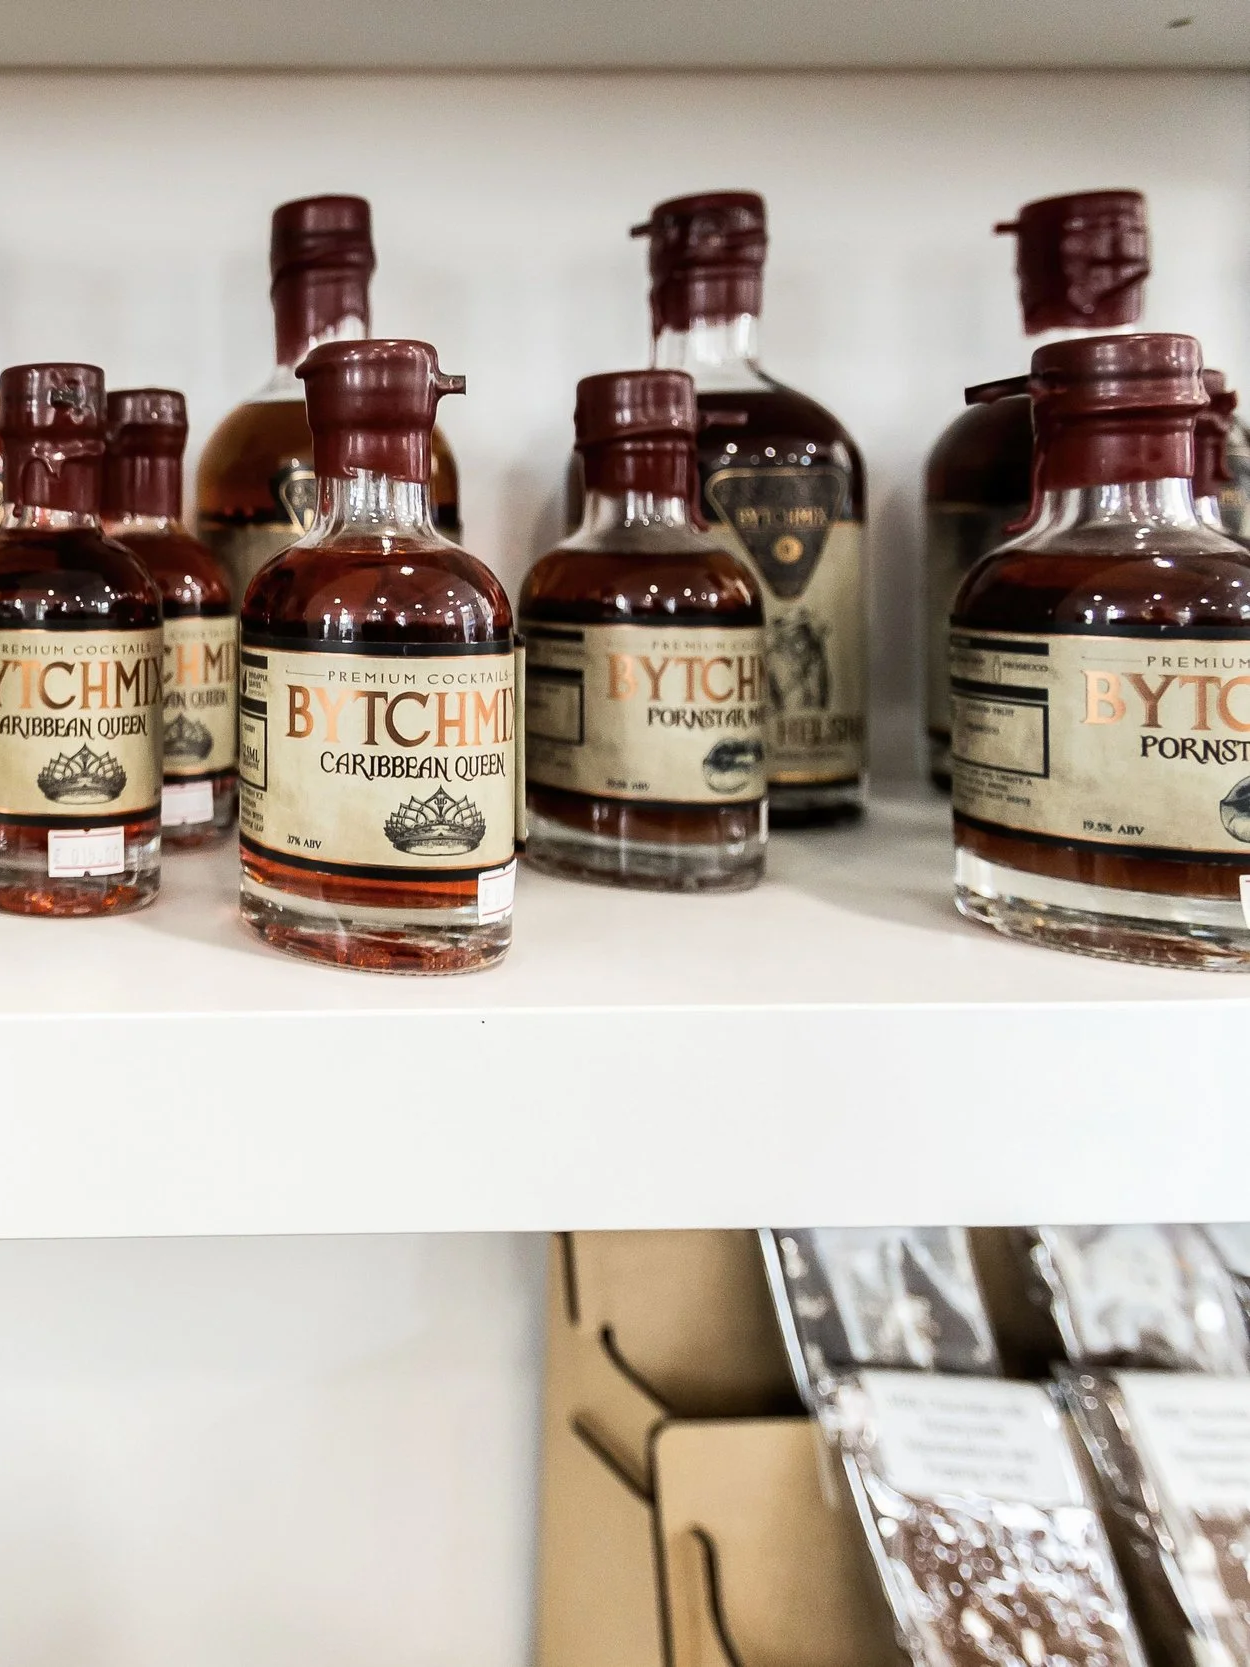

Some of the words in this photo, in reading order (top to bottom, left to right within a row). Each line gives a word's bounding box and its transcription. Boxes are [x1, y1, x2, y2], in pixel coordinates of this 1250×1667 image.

[1147, 655, 1250, 669] PREMIUM
[327, 670, 417, 685] PREMIUM
[427, 670, 509, 686] COCKTAILS
[1079, 669, 1250, 733] BYTC
[98, 714, 149, 740] QUEEN
[647, 706, 746, 731] PORNSTAR
[1140, 734, 1250, 766] PORNST
[320, 751, 452, 783] CARIBBEAN
[455, 752, 506, 782] QUEEN
[286, 834, 301, 848] 37%
[303, 838, 322, 851] ABV
[1117, 823, 1145, 837] ABV
